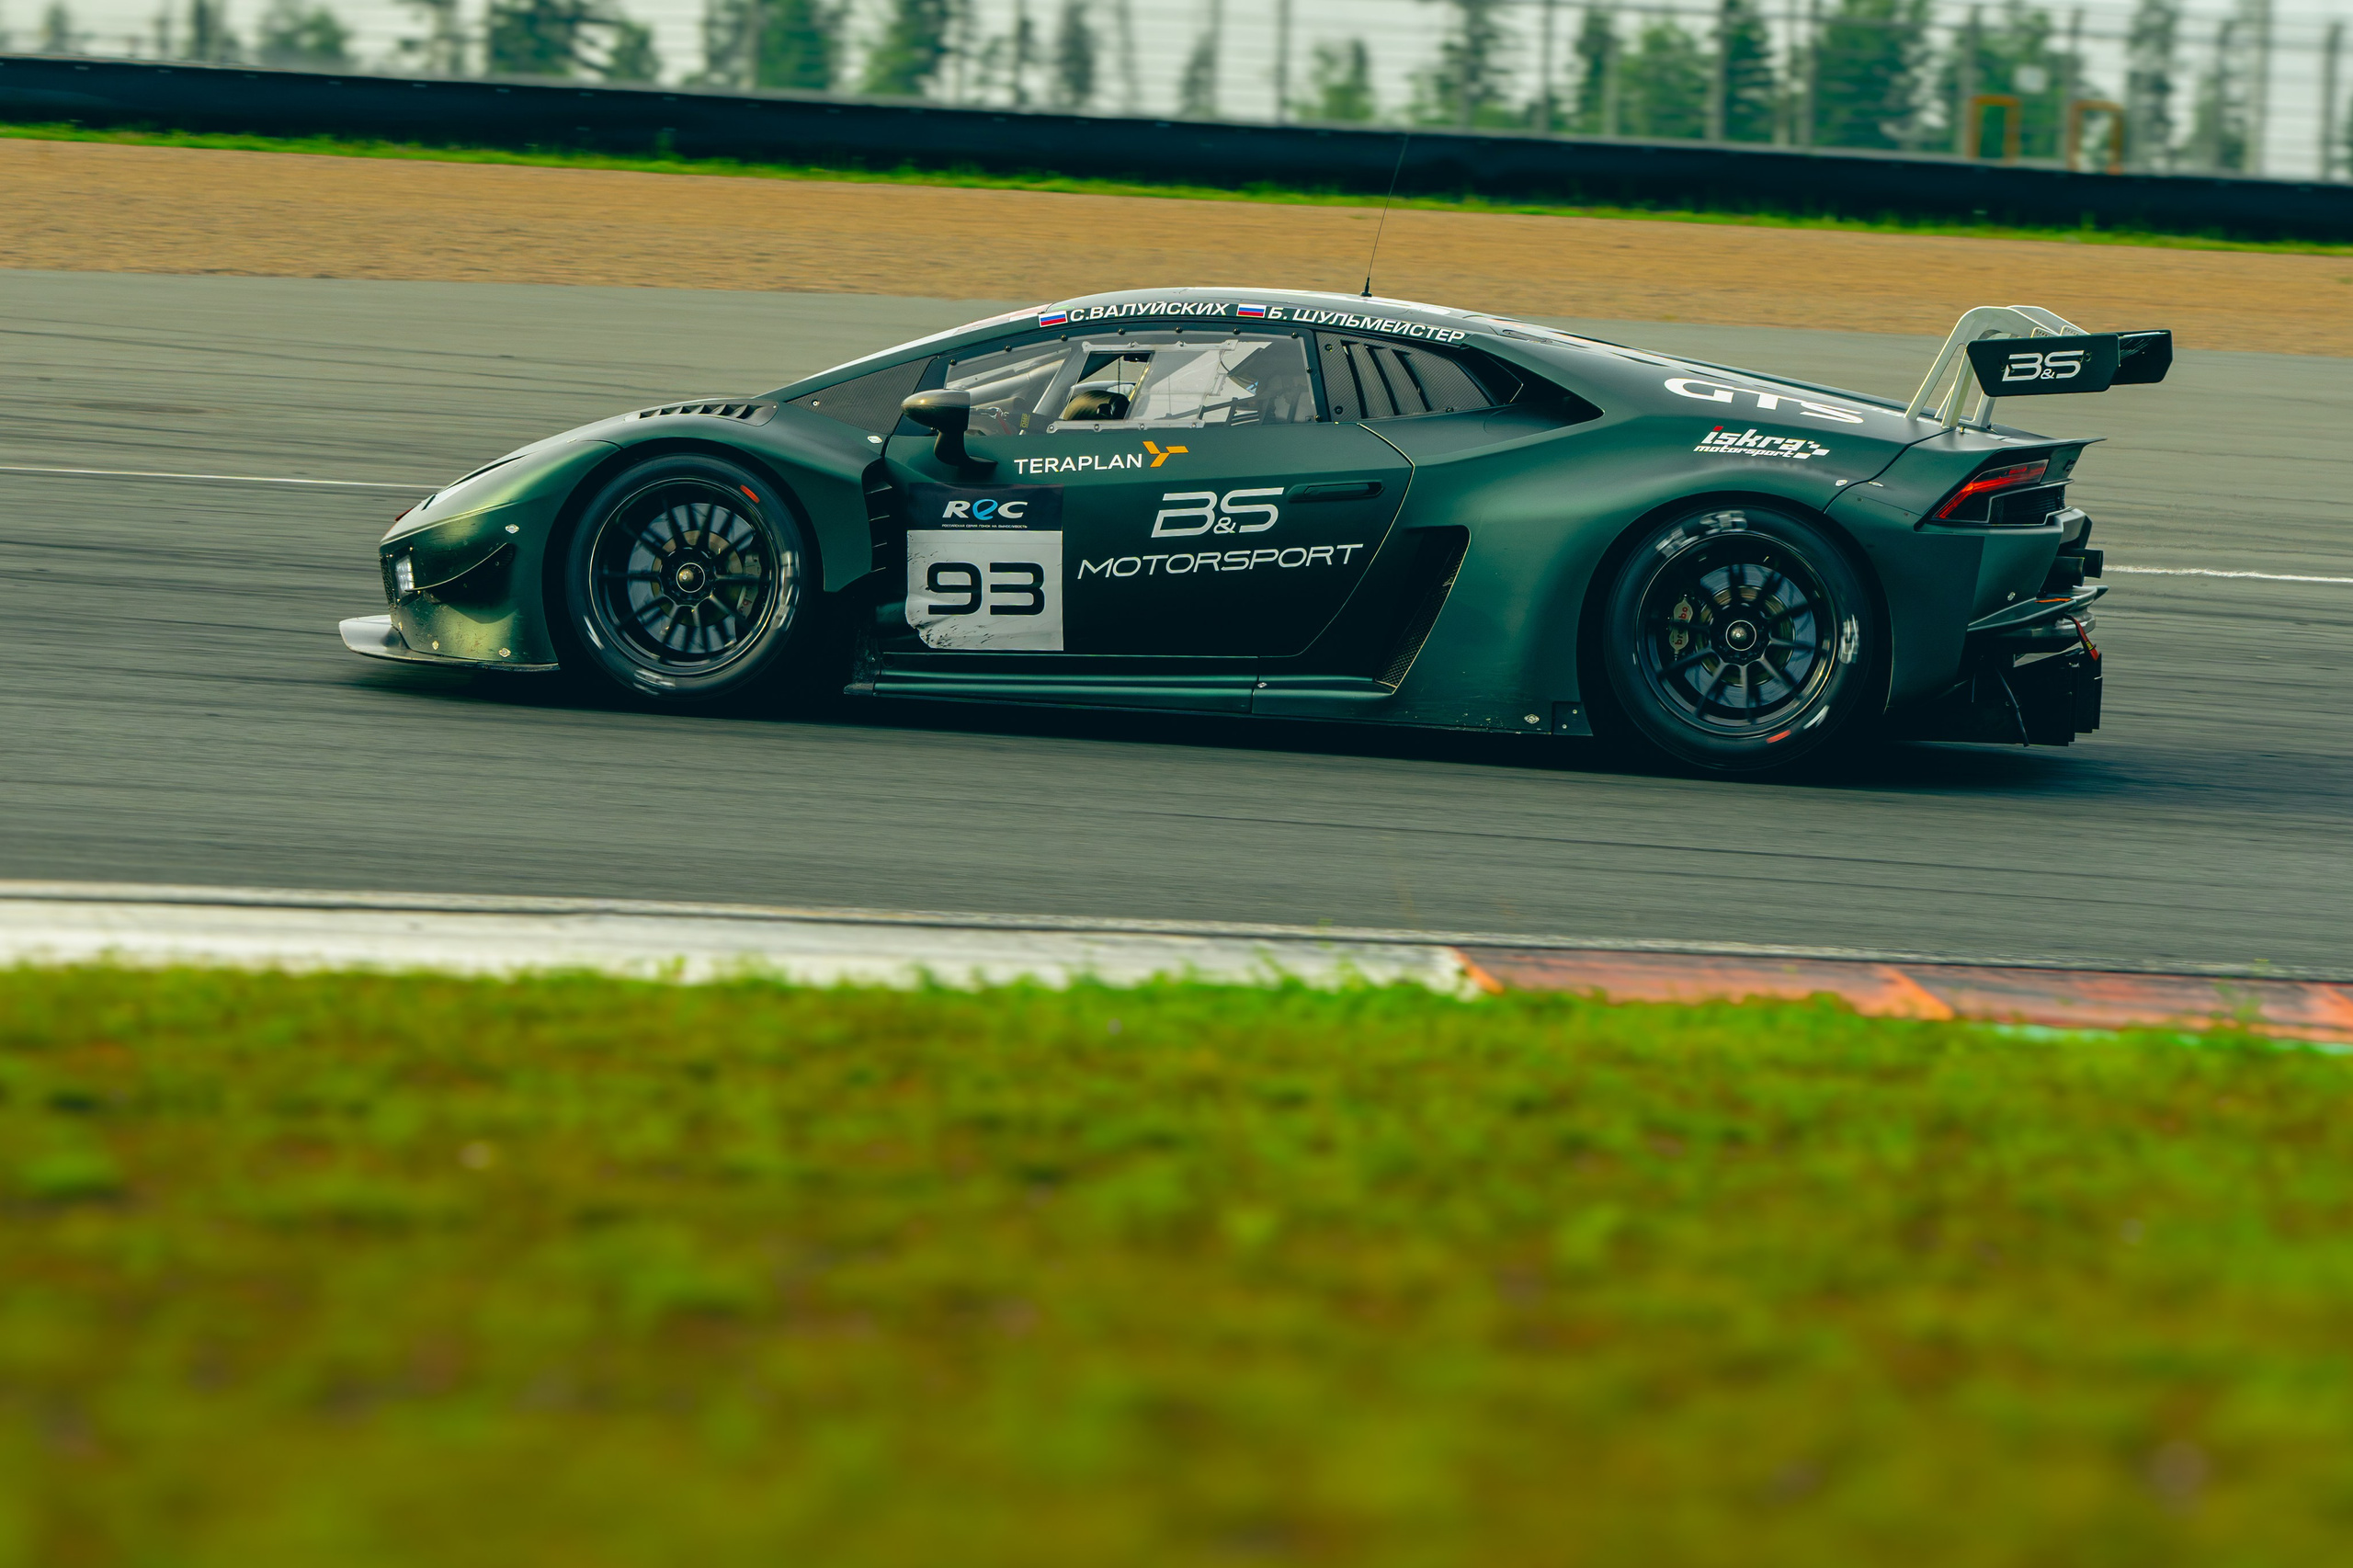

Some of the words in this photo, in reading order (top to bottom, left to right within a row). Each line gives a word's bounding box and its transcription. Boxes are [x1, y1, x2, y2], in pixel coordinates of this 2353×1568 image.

[1070, 301, 1229, 322] С.ВАЛУЙСКИХ
[1267, 307, 1287, 319] Б.
[2002, 350, 2085, 381] B&S
[1664, 378, 1864, 424] GTS
[1693, 445, 1794, 458] motorsport
[1701, 426, 1806, 450] iskra
[1014, 454, 1142, 475] TERAPLAN
[1151, 487, 1285, 539] B&S
[1077, 544, 1364, 580] MOTORSPORT
[927, 562, 1045, 617] 93
[1675, 607, 1688, 644] brbo
